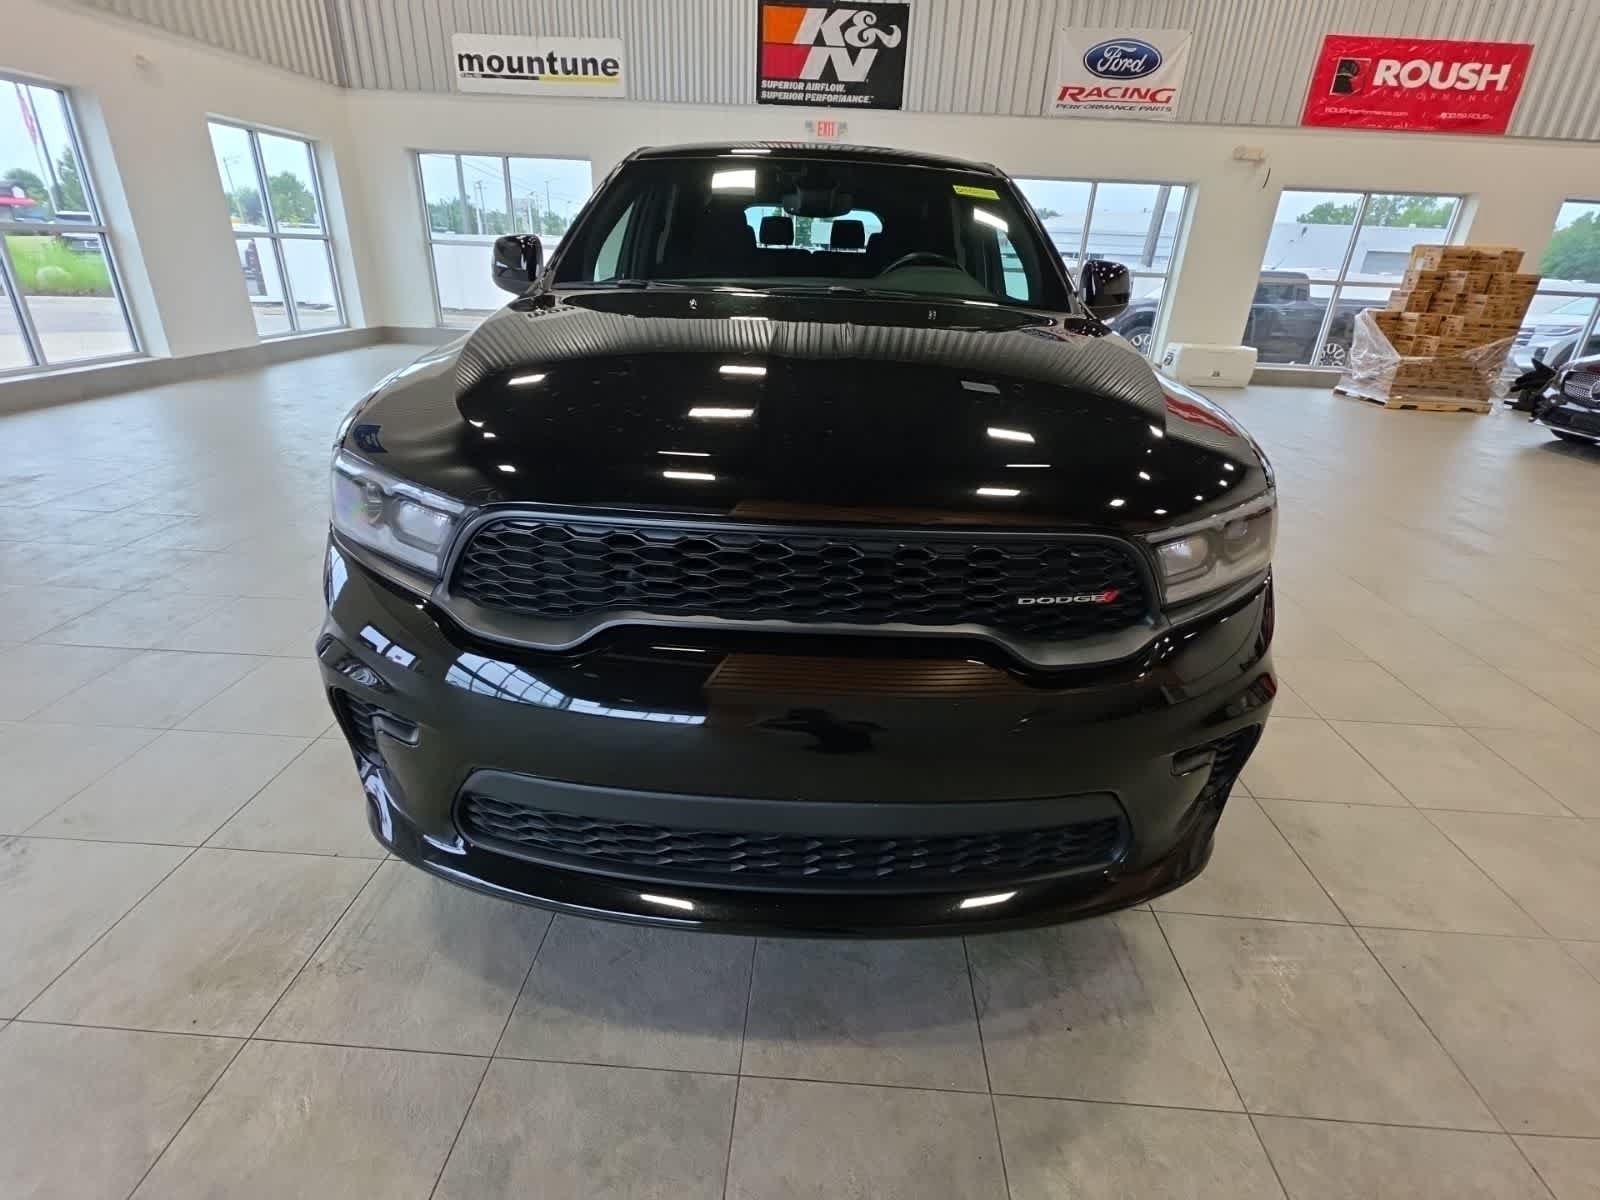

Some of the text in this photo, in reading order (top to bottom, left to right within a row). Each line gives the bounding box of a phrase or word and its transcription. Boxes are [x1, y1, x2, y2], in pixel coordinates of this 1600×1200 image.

[457, 50, 620, 76] mountune
[1097, 45, 1148, 73] Ford
[1372, 58, 1512, 92] ROUSH
[761, 80, 846, 92] SUPERIOR AIRFLOW.
[760, 90, 804, 101] SUPERIOR
[1057, 86, 1177, 104] RACING
[1056, 103, 1137, 112] PERFORMANCE
[817, 121, 836, 137] EXIT
[1017, 594, 1105, 605] DODGE
